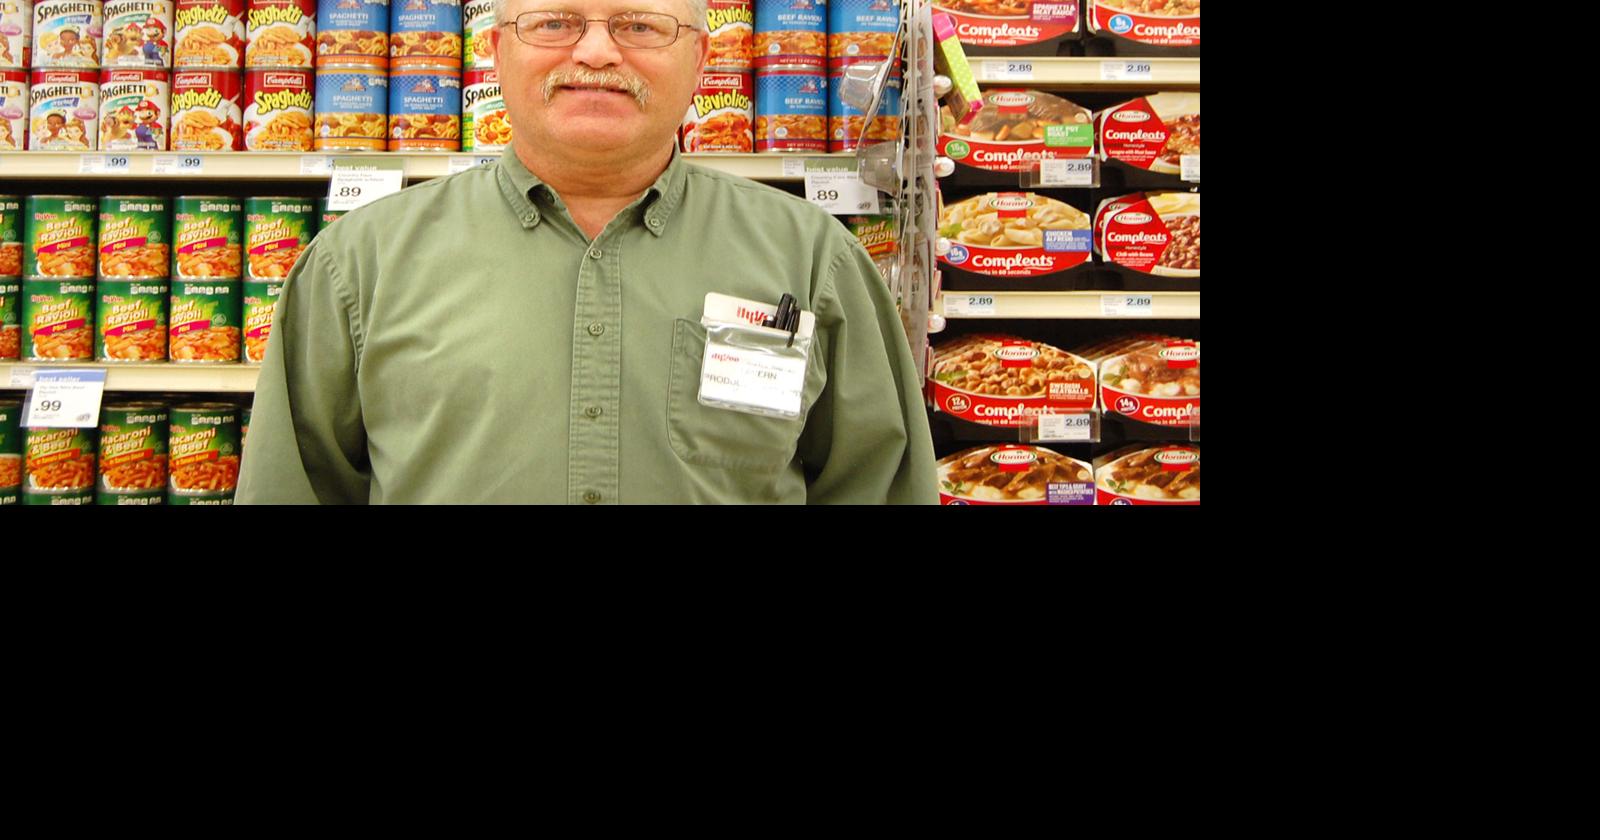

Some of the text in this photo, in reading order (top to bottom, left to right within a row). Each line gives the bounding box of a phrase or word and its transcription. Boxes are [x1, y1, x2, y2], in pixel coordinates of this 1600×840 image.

[176, 5, 228, 31] Spaghetti
[248, 5, 303, 31] Spaghetti
[958, 21, 1039, 40] Compleats
[1009, 64, 1033, 73] 2.89
[1127, 64, 1151, 73] 2.89
[254, 88, 312, 115] Spaghetti
[693, 89, 750, 118] Raviolios
[1105, 129, 1166, 142] Compleats
[973, 148, 1055, 165] Compleats
[1067, 163, 1091, 172] 2.89
[335, 186, 361, 197] .89
[812, 190, 839, 201] .89
[46, 217, 77, 232] Beef
[105, 217, 131, 232] Beef
[184, 217, 212, 232] Beef
[255, 218, 284, 232] Beef
[857, 221, 886, 236] Beef
[40, 226, 82, 243] Ravioli
[180, 226, 219, 243] Ravioli
[251, 227, 291, 244] Ravioli
[1108, 231, 1167, 245] Compleats
[972, 253, 1054, 270] Compleats
[42, 299, 71, 313] Beef
[112, 299, 142, 314] Beef
[968, 297, 993, 306] 2.89
[1126, 298, 1151, 307] 2.89
[36, 308, 78, 325] Ravioli
[107, 309, 149, 326] Ravioli
[34, 400, 62, 411] .99
[974, 403, 1056, 420] Compleats
[1065, 418, 1090, 428] 2.89
